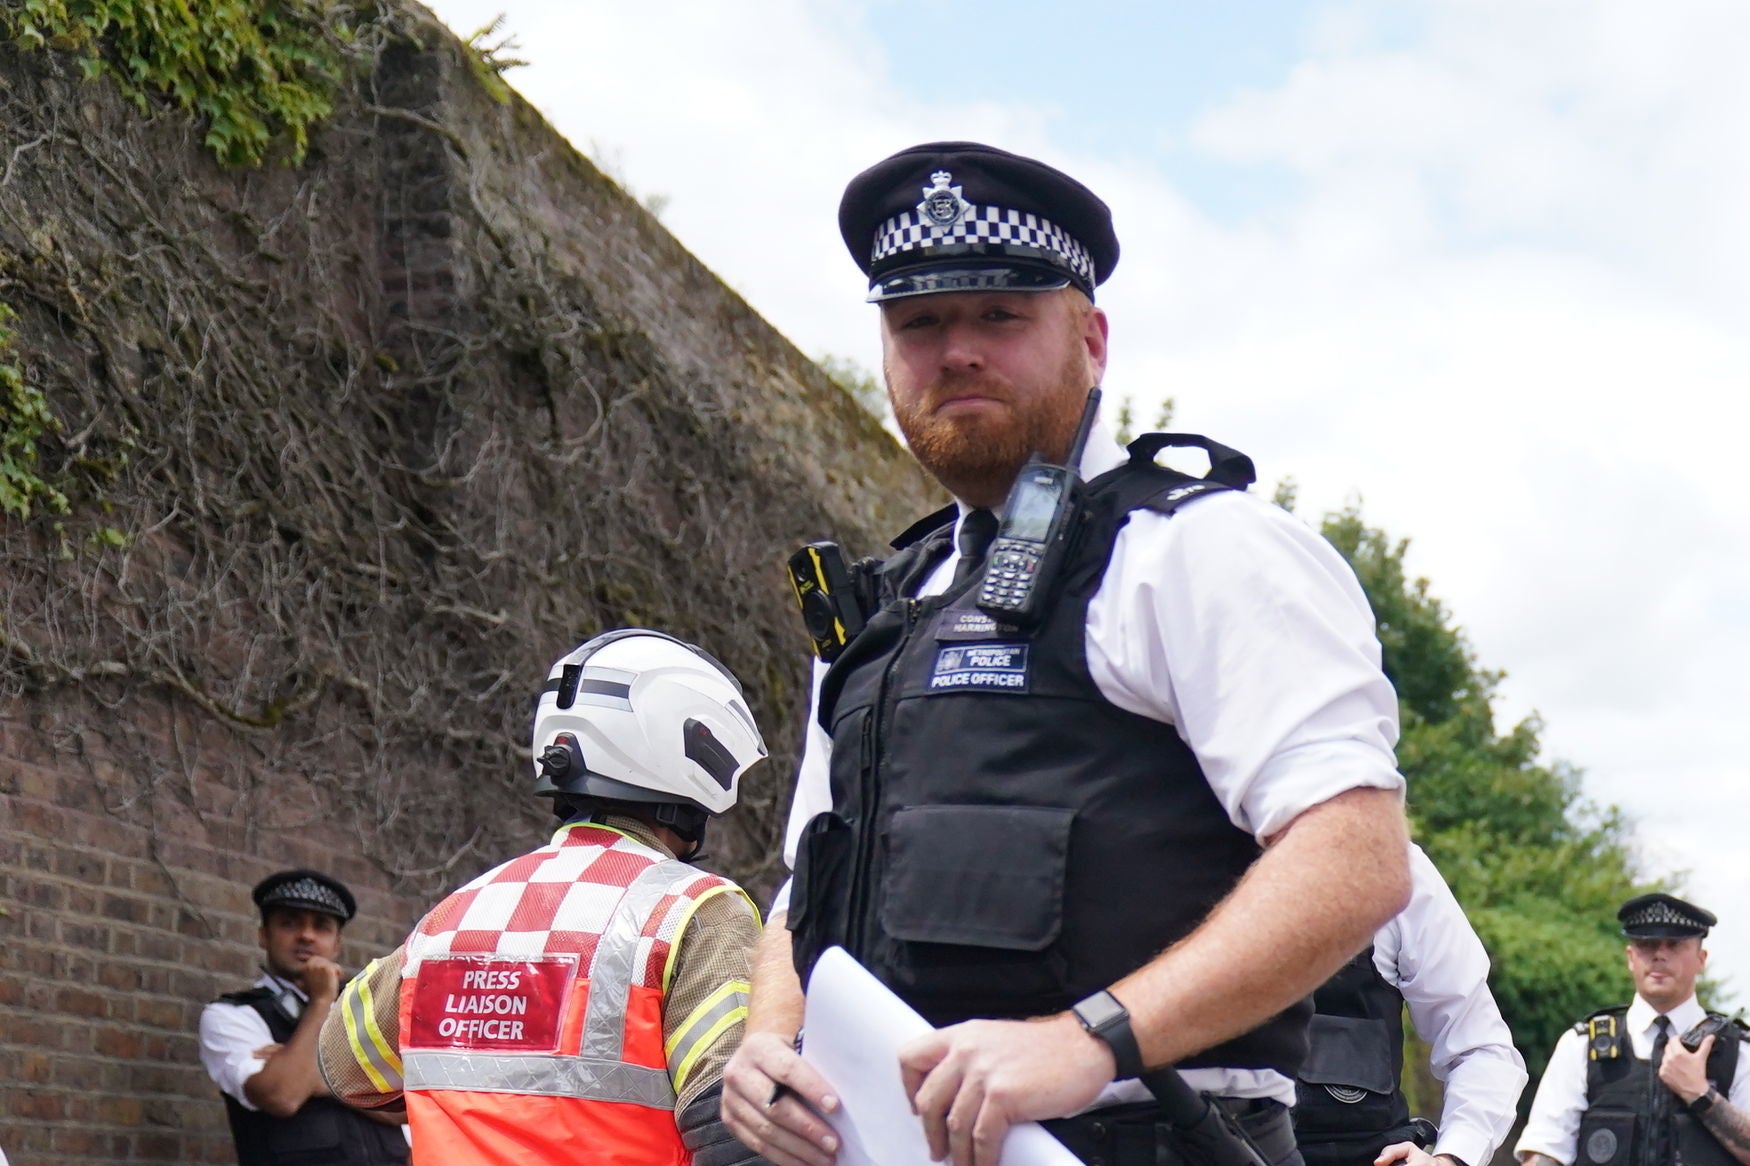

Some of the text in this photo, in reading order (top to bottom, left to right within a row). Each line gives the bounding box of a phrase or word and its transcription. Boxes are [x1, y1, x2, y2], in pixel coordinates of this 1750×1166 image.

[970, 655, 1012, 667] POLICE
[931, 673, 1025, 688] POLICE OFFICER
[463, 970, 522, 990] PRESS
[445, 994, 527, 1015] LIAISON
[438, 1017, 525, 1040] OFFICER
